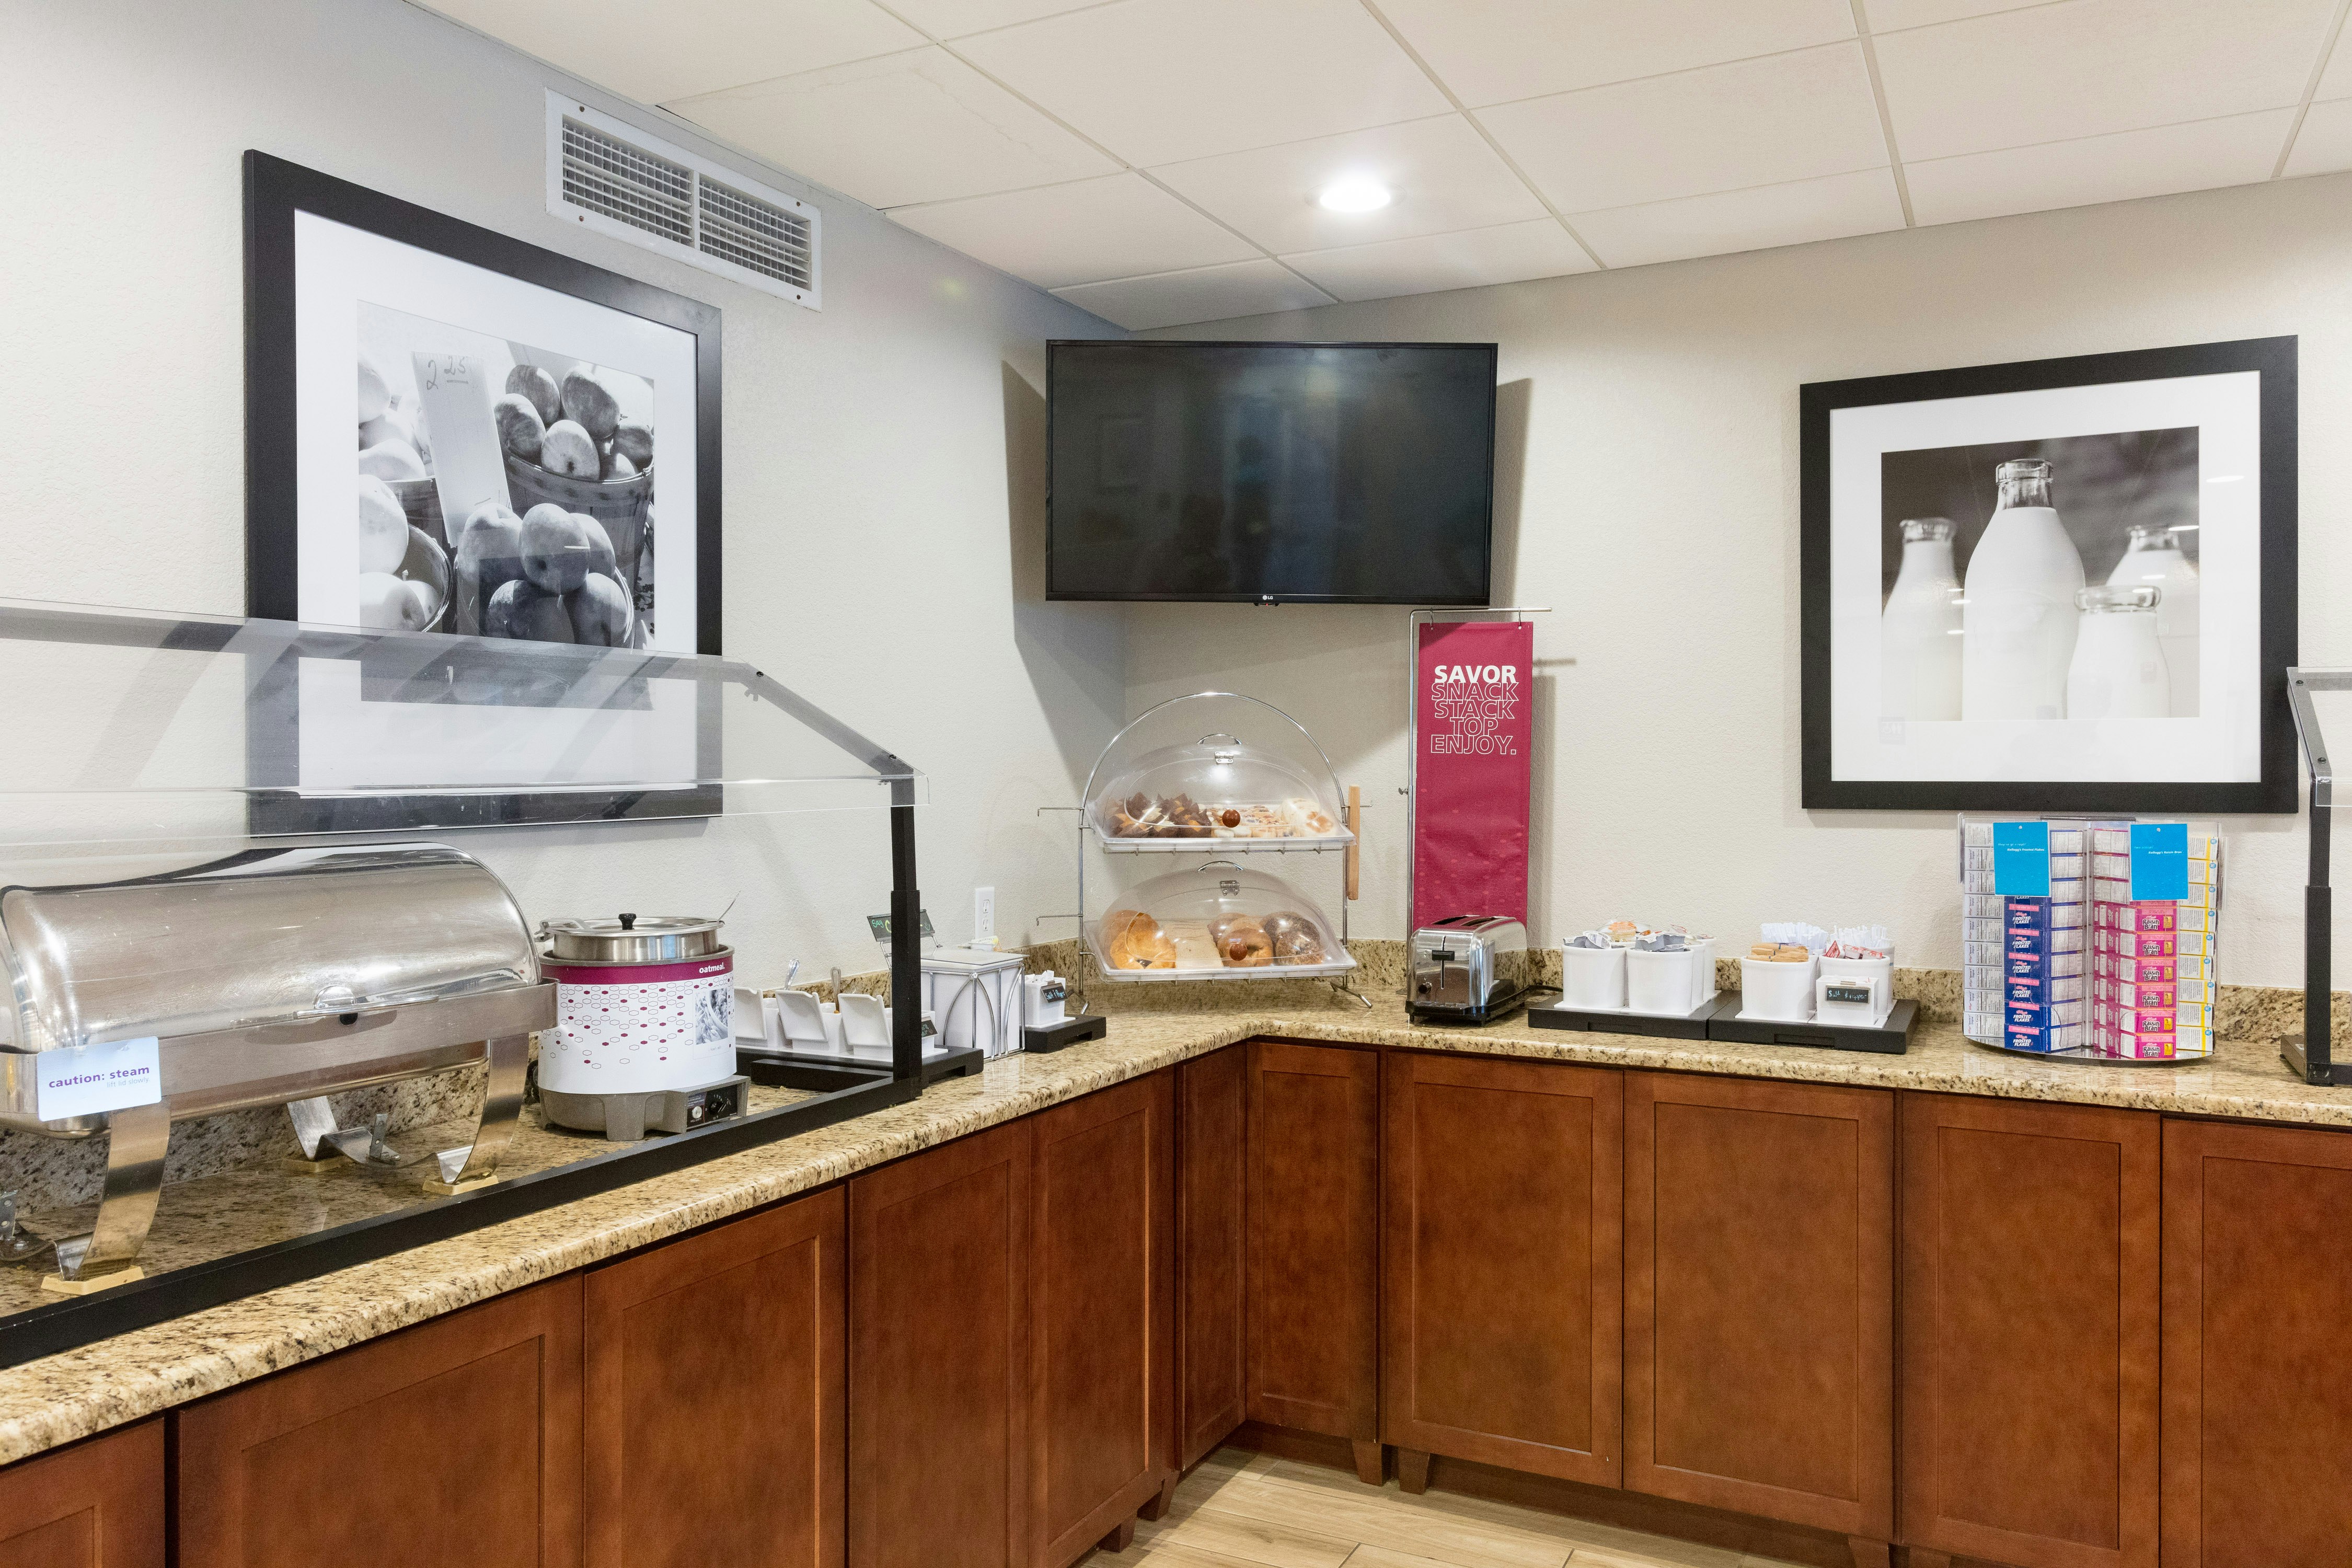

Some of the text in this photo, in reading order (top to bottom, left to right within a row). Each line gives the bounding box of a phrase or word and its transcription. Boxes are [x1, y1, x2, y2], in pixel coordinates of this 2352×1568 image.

[1435, 665, 1516, 683] SAVOR
[1432, 682, 1519, 701] SNACK
[1435, 700, 1515, 719] STACK
[1450, 717, 1498, 736] TOP
[1431, 735, 1516, 754] ENJOY.
[871, 919, 884, 928] Say
[699, 962, 725, 974] oatmeal.
[49, 1067, 150, 1088] caution: steam
